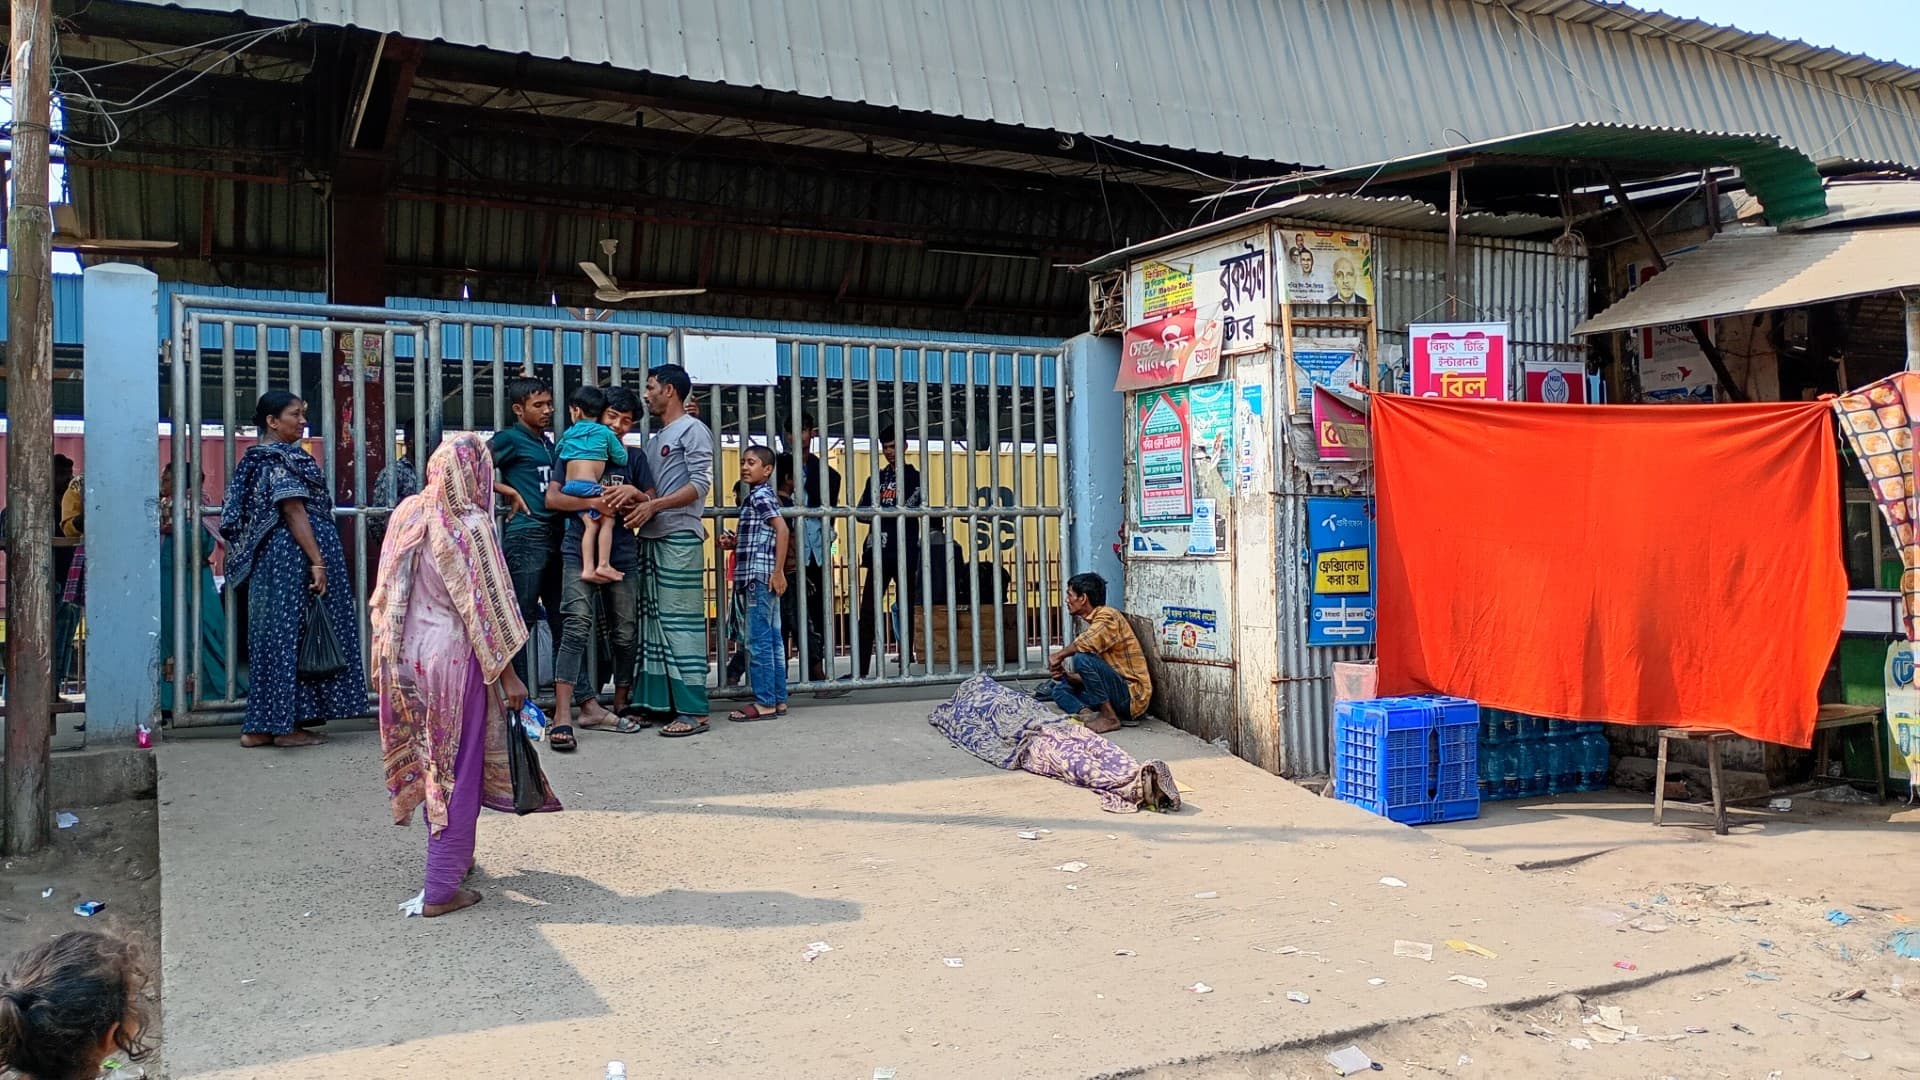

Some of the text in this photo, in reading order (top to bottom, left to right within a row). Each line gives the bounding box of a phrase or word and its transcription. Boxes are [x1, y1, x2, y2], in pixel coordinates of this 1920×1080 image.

[1438, 356, 1479, 367] ইন্টারনেট
[1439, 371, 1487, 398] বিল
[1326, 574, 1360, 585] করা হয়
